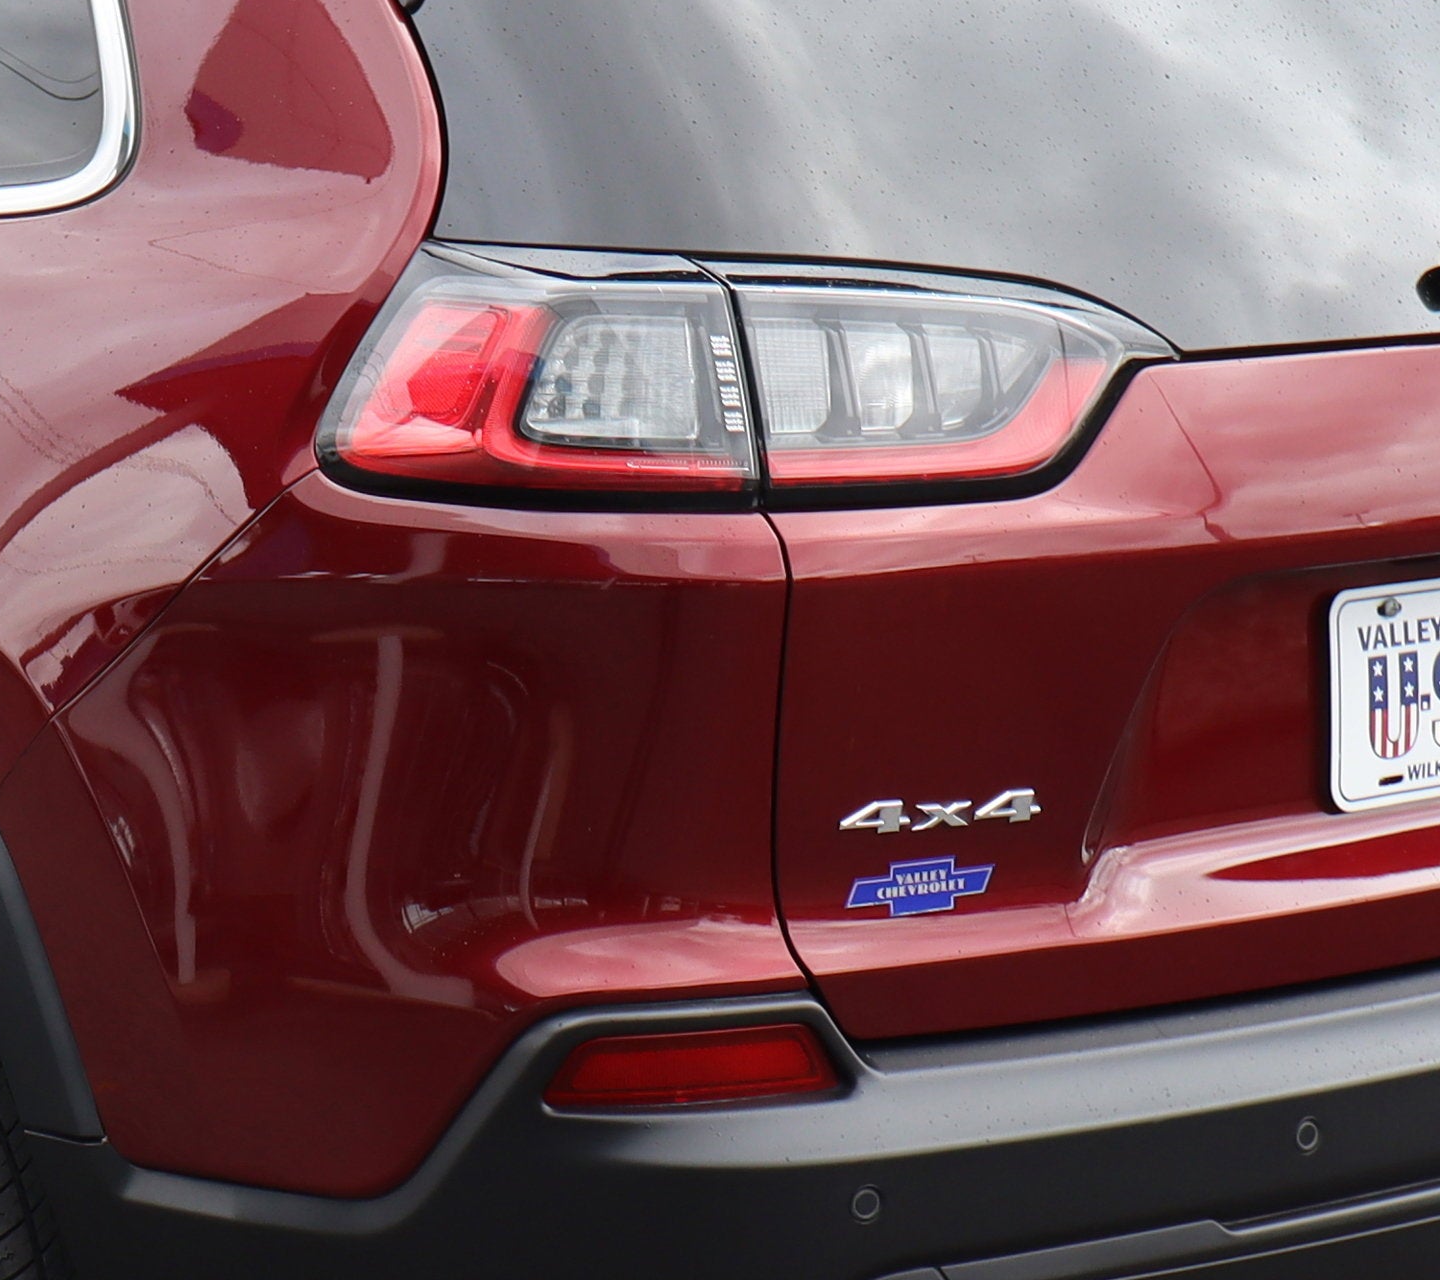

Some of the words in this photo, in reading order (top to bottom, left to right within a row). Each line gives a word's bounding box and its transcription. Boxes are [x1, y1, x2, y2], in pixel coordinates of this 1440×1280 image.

[838, 787, 1042, 835] 4x4
[876, 877, 966, 900] CHEVROLET
[895, 868, 949, 886] VALLEY
